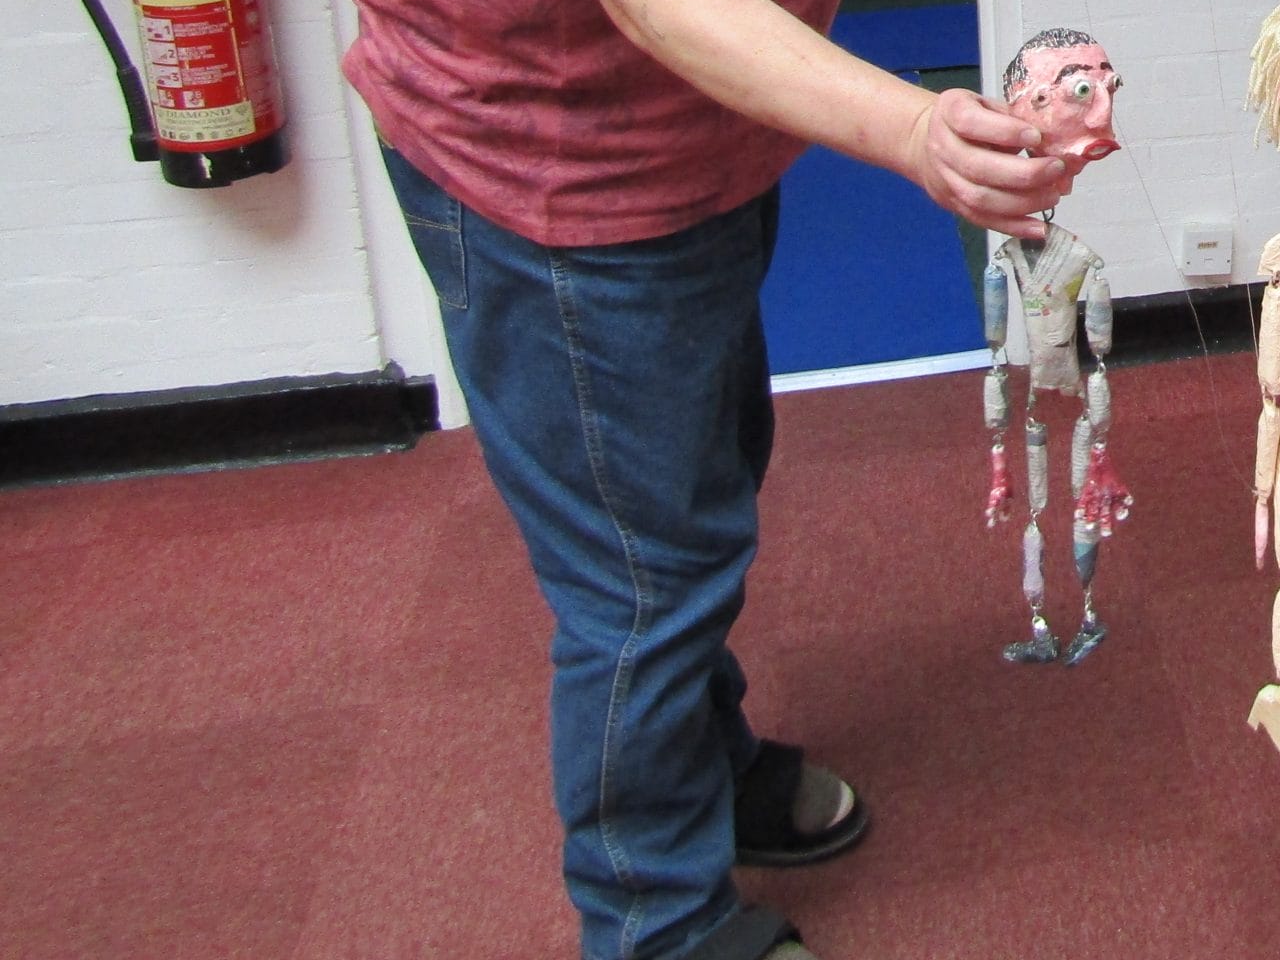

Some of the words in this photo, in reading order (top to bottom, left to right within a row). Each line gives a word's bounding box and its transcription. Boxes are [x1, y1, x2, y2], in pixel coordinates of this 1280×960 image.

[164, 25, 171, 35] 1
[168, 49, 175, 58] 2
[171, 72, 180, 82] 3
[166, 108, 231, 119] DIAMOND
